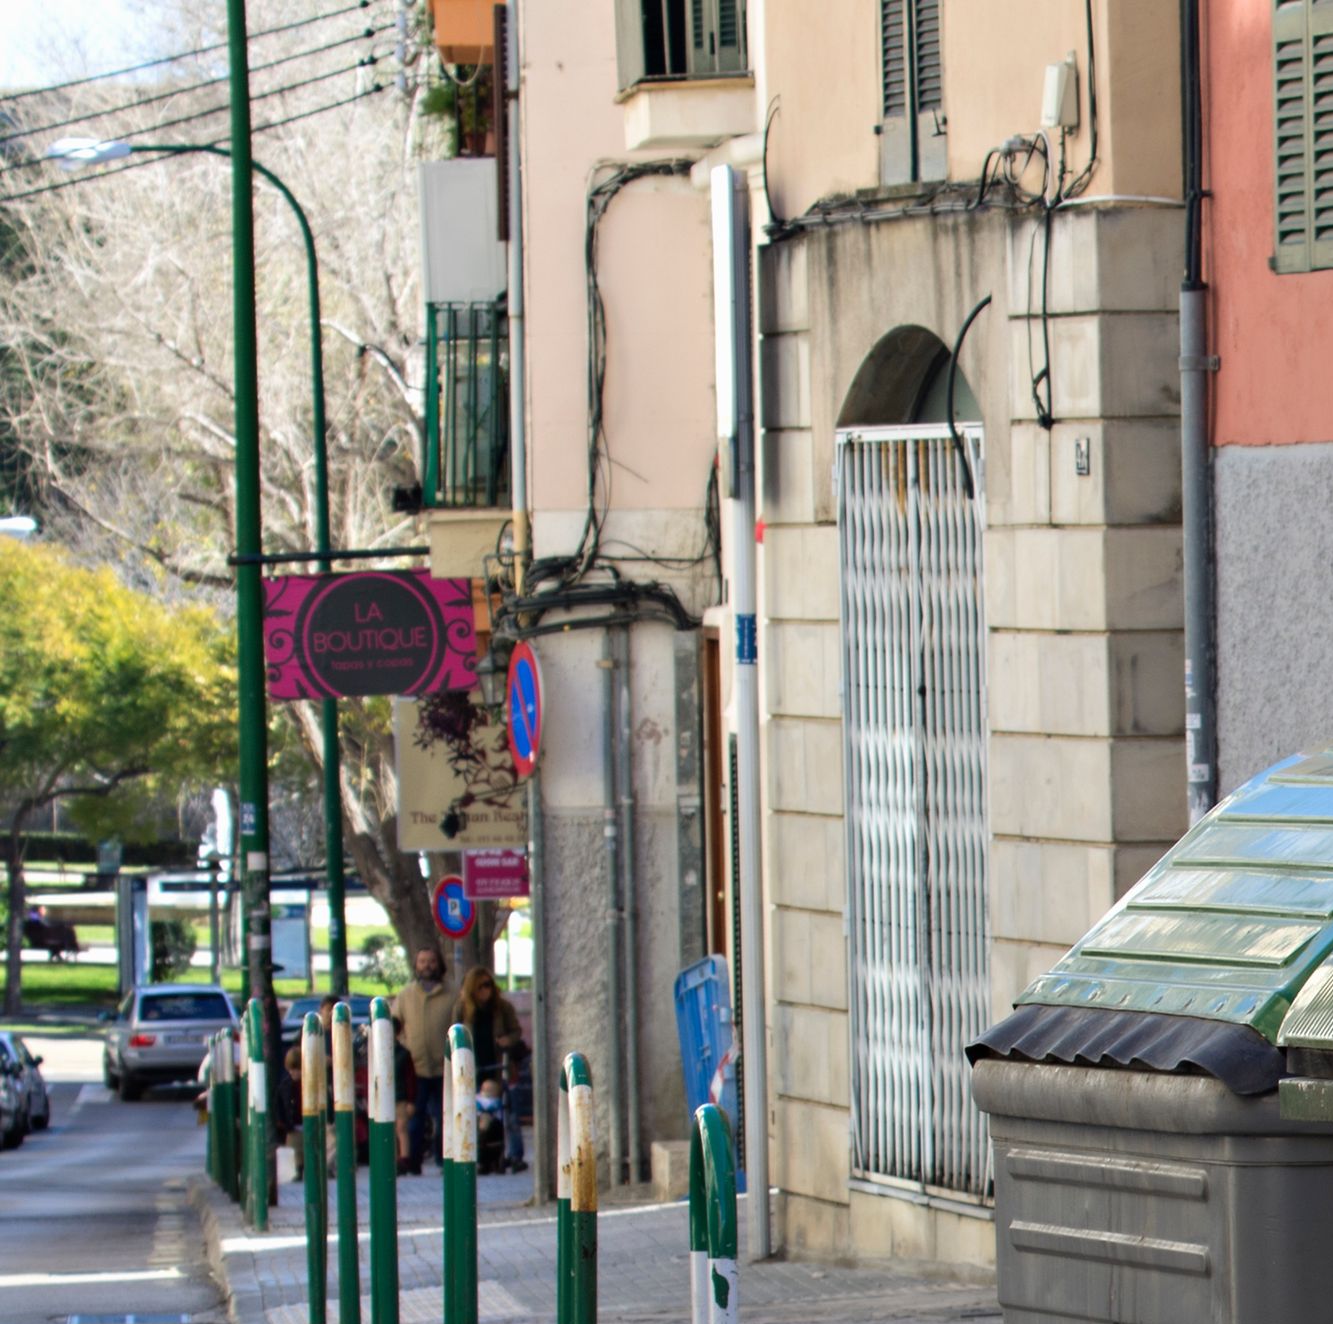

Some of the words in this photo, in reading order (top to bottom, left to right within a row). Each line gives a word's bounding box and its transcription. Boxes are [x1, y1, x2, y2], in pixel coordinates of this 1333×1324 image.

[355, 602, 384, 623] LA
[313, 626, 428, 653] BOUTIQUE
[410, 811, 437, 824] The
